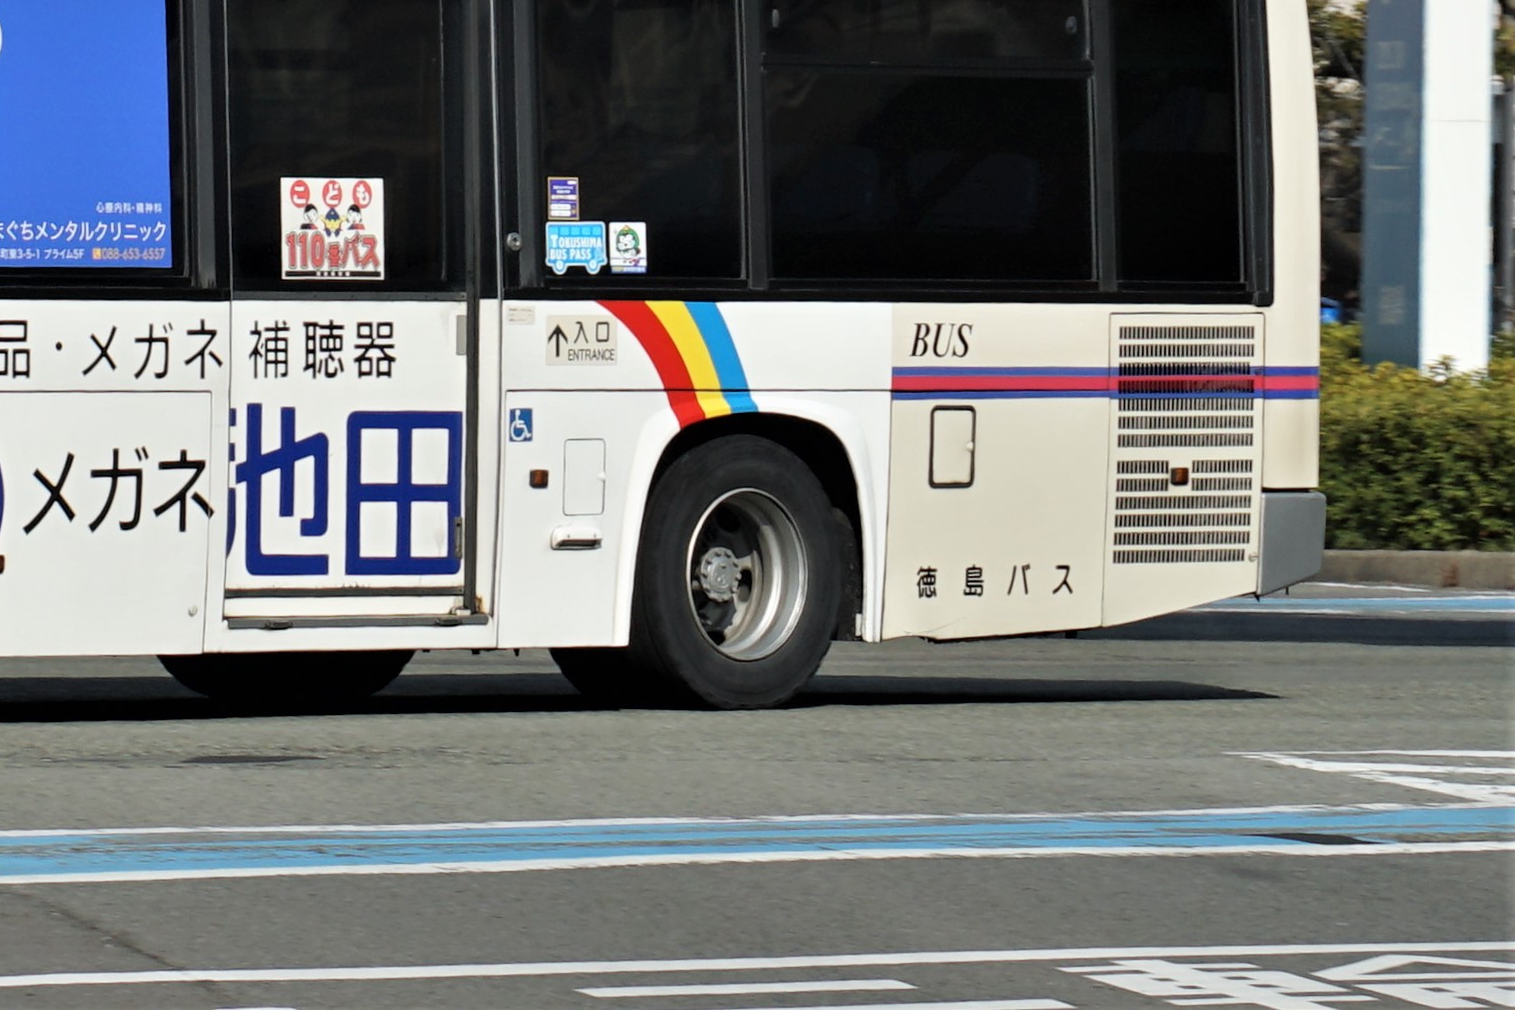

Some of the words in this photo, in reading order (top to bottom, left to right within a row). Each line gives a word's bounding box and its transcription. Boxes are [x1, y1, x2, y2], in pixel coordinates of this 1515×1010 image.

[293, 183, 370, 205] こども
[550, 234, 602, 248] TOKUSHIMA
[549, 249, 568, 260] BUS
[570, 249, 591, 260] PASS
[574, 321, 609, 344] 入口
[909, 322, 973, 358] BUS
[248, 320, 397, 379] 補聴器
[568, 349, 615, 361] ENTRANCE
[23, 448, 215, 533] メガネ
[916, 564, 1074, 598] 徳島バス
